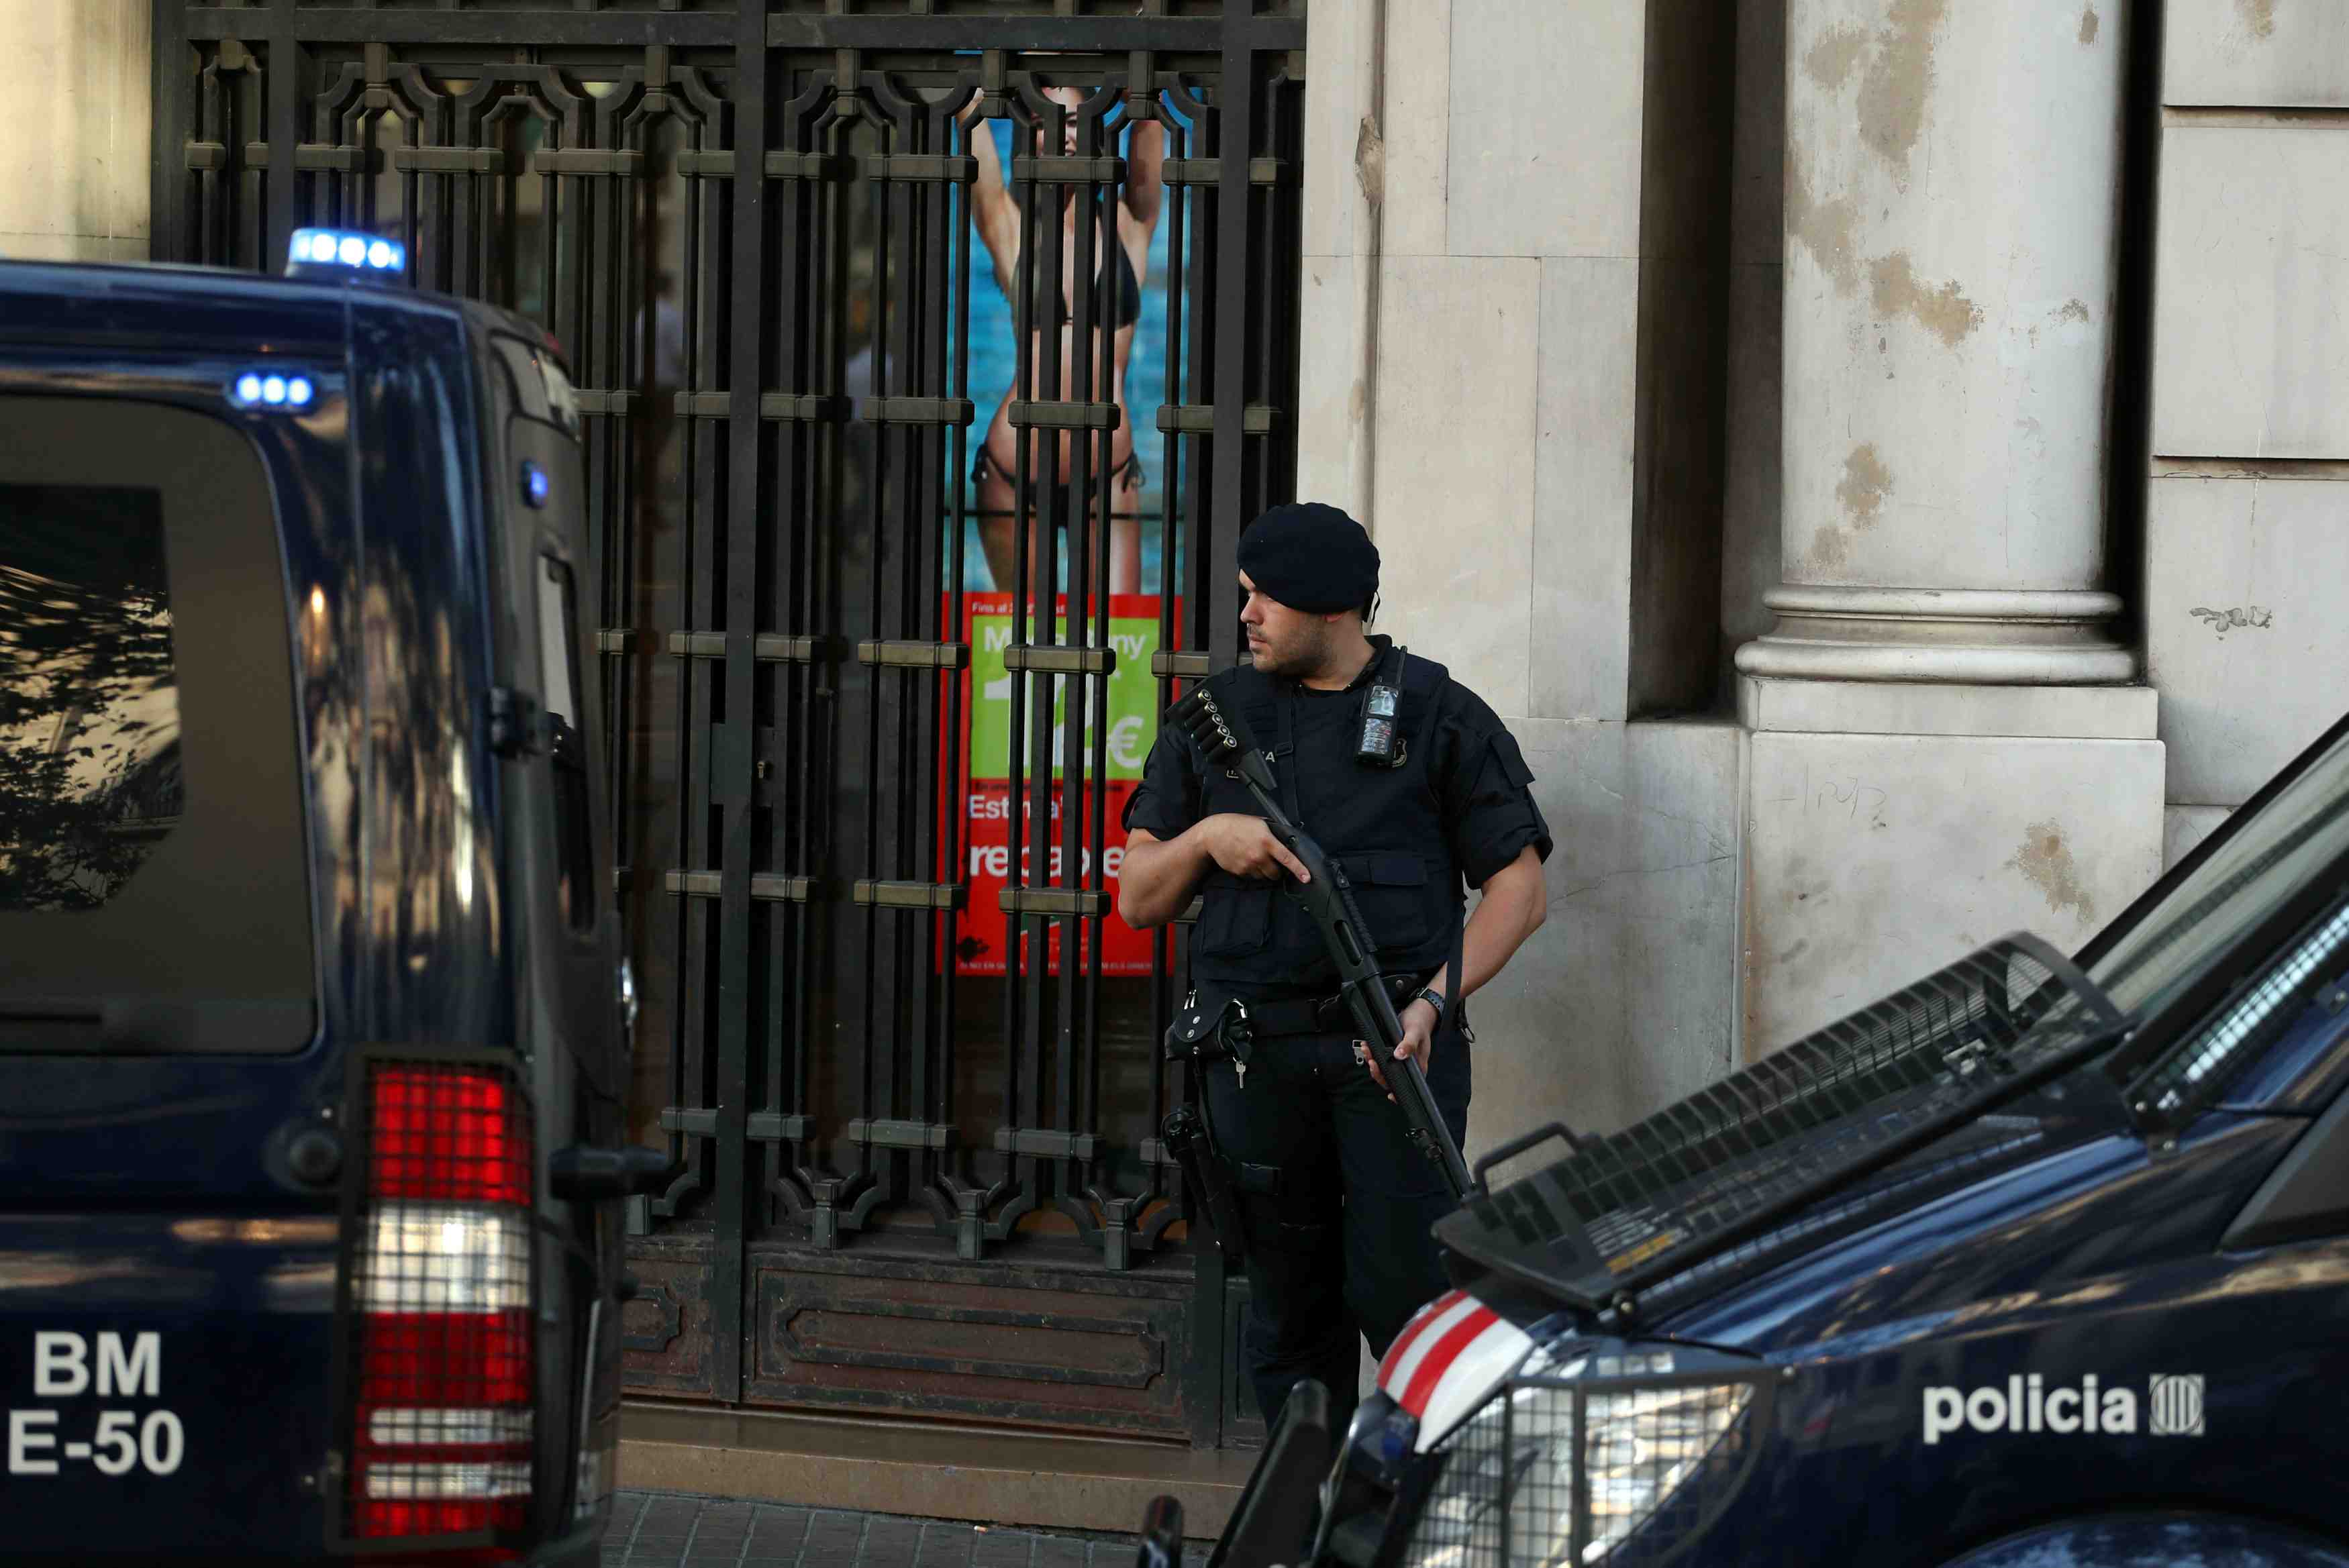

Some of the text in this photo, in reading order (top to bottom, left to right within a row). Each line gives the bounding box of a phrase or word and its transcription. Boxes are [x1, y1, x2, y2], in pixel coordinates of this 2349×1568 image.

[33, 1330, 161, 1396] BM
[1923, 1373, 2138, 1445] policia
[8, 1410, 184, 1475] E-50
